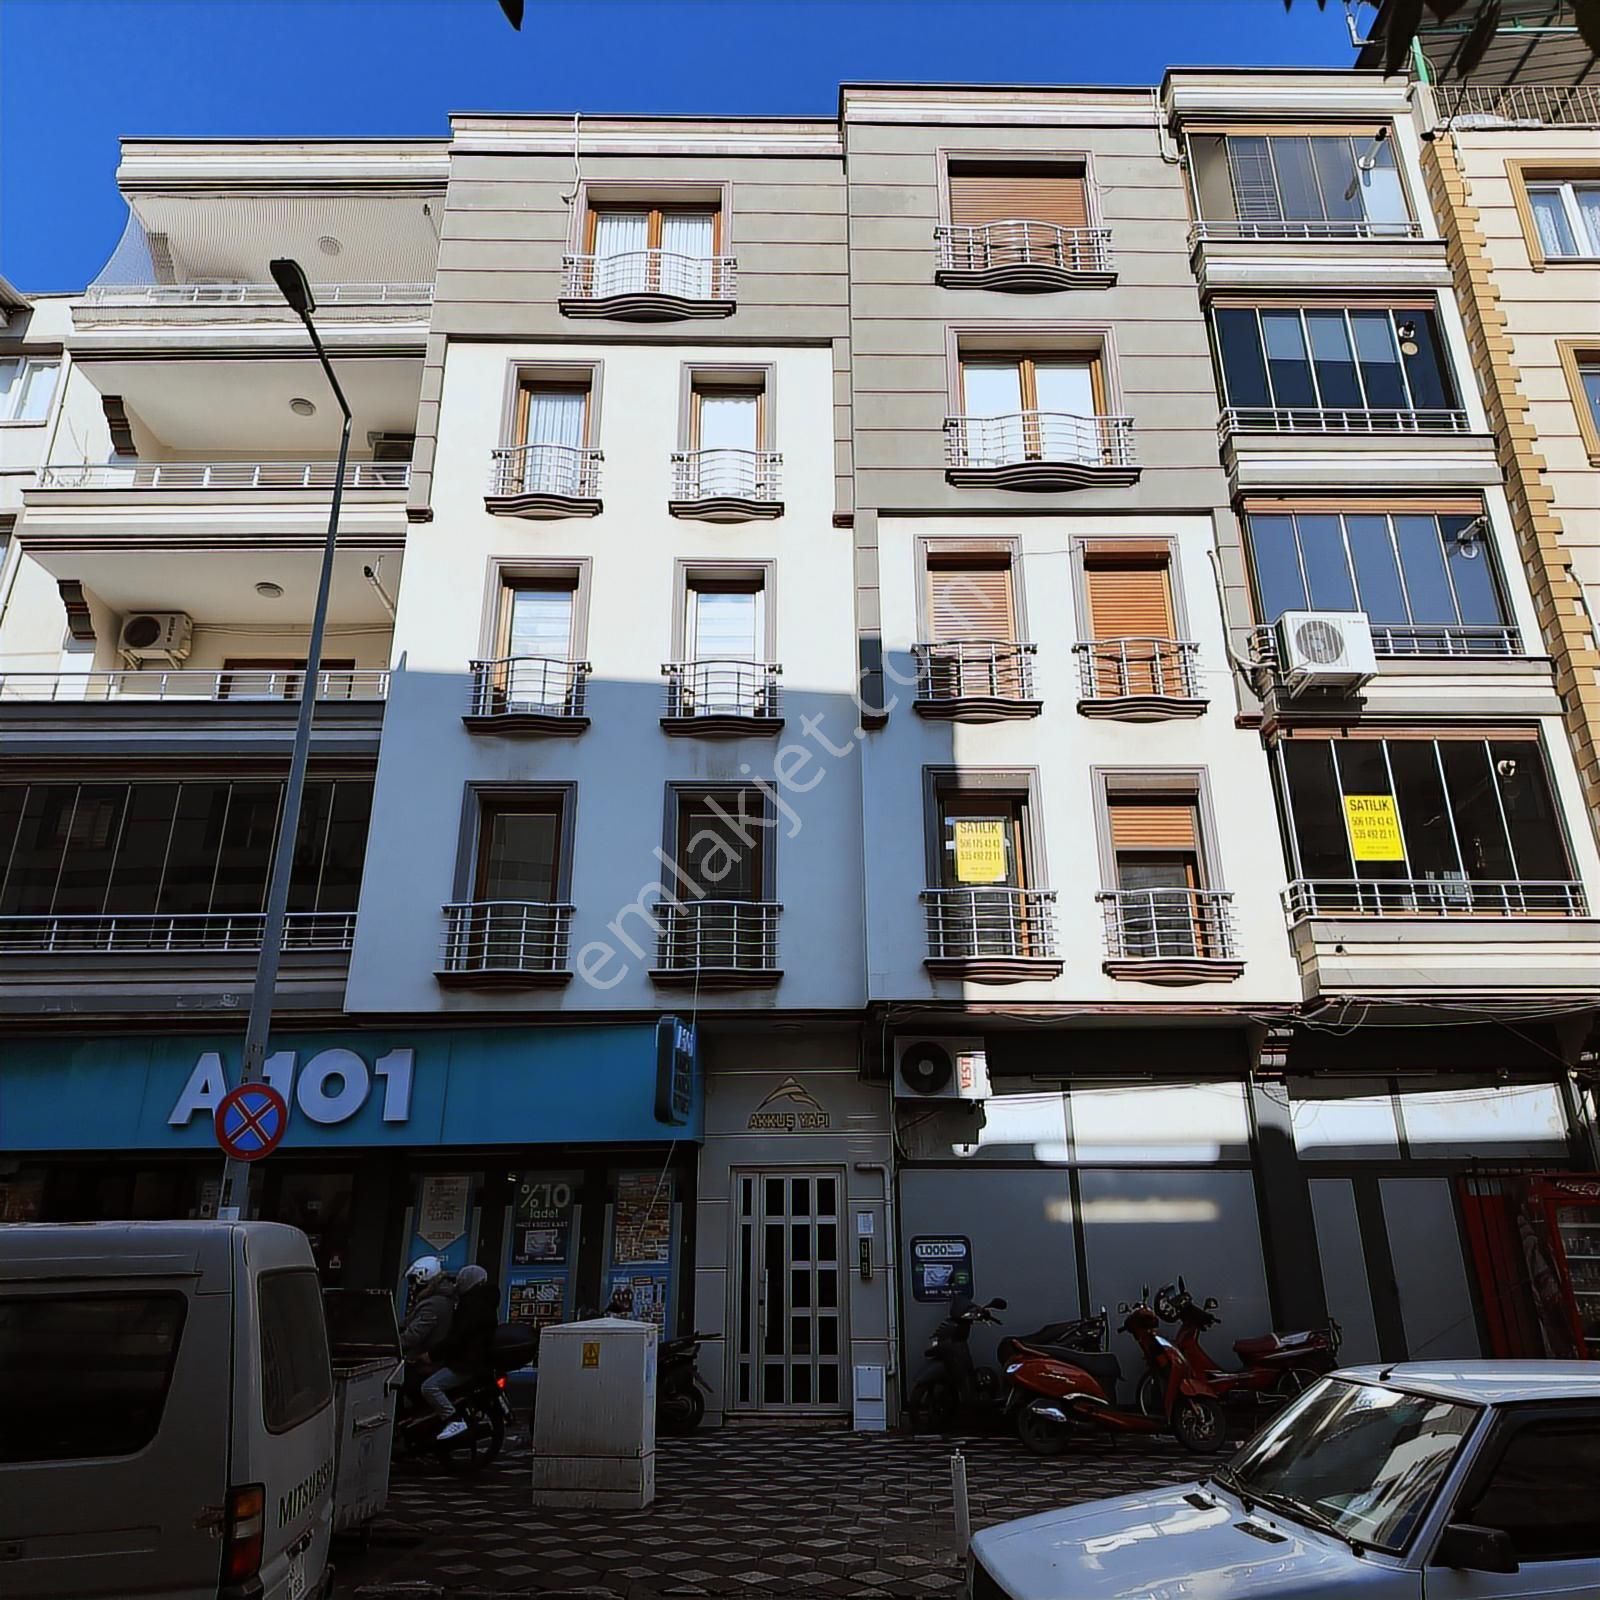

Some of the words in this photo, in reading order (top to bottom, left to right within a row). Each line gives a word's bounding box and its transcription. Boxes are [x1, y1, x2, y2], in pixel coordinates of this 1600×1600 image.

[1349, 799, 1390, 812] SATILIK
[960, 821, 999, 834] SATILIK
[1388, 829, 1396, 839] 11
[168, 1047, 415, 1126] A101
[748, 1113, 796, 1131] AKKUŞ
[798, 1113, 830, 1128] YAPI
[520, 1183, 571, 1208] %10
[278, 1455, 334, 1528] MITSUBISH
